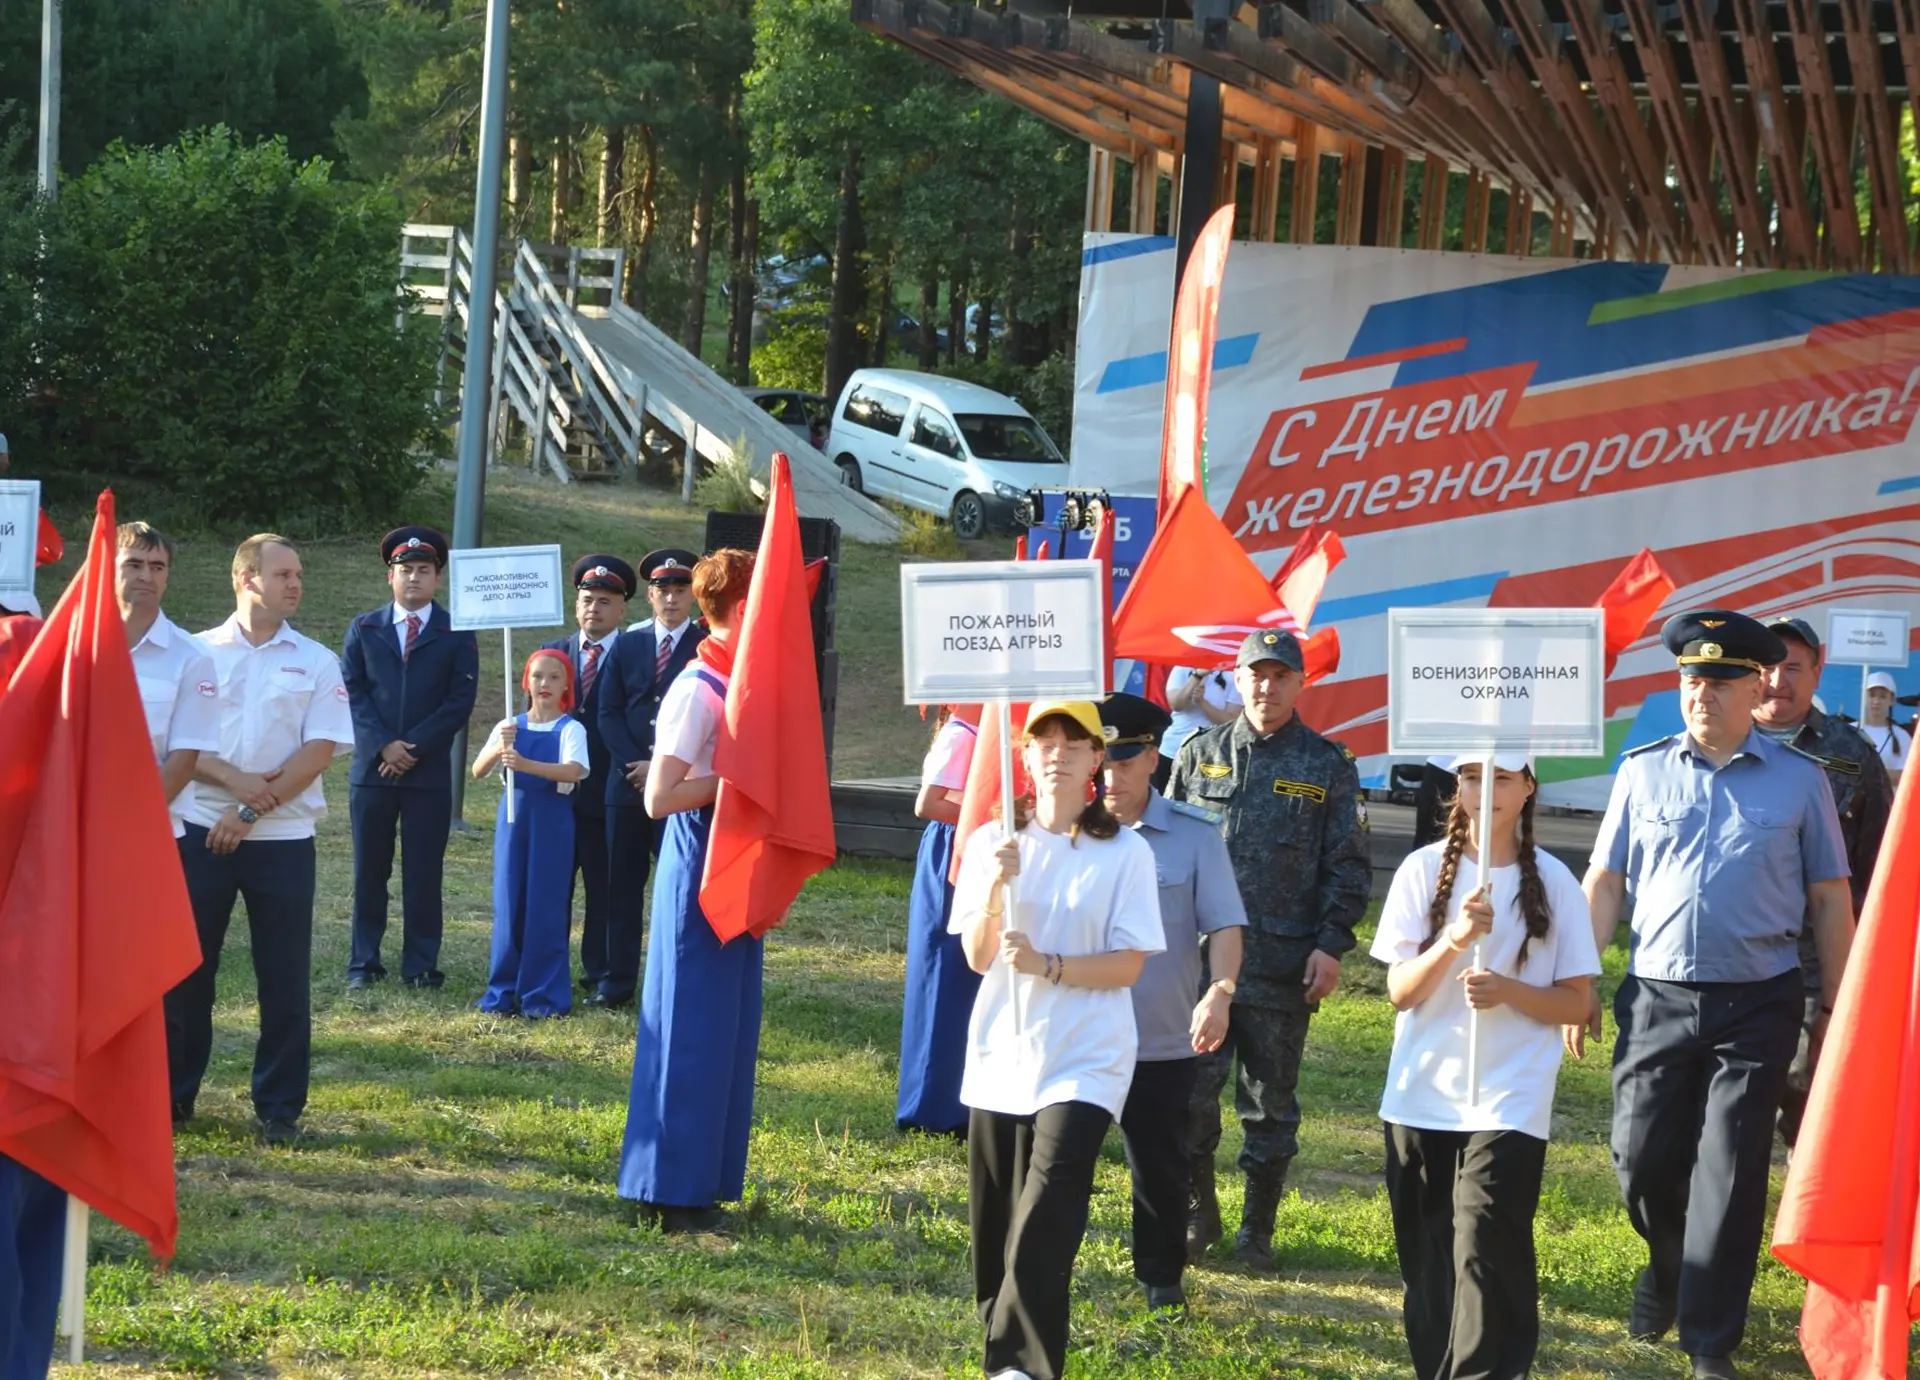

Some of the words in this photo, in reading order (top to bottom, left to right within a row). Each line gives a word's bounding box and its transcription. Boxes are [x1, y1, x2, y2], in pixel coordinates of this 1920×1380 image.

[1268, 409, 1317, 468] С
[1316, 388, 1509, 469] Днем
[1233, 365, 1920, 539] железнодорожника!
[473, 572, 540, 583] ЛОКОМОТИВНОЕ
[464, 581, 549, 593] ЭКСПЛУАТАЦИОННОЕ
[482, 592, 505, 602] ДЕПО
[506, 591, 532, 600] АГРЫЗ
[949, 609, 1055, 630] ПОЖАРНЫЙ
[943, 635, 1003, 652] ПОЕЗД
[1007, 634, 1063, 650] АГРЫЗ
[1412, 666, 1579, 680] ВОЕНИЗИРОВАННАЯ
[1460, 686, 1530, 700] ОХРАНА
